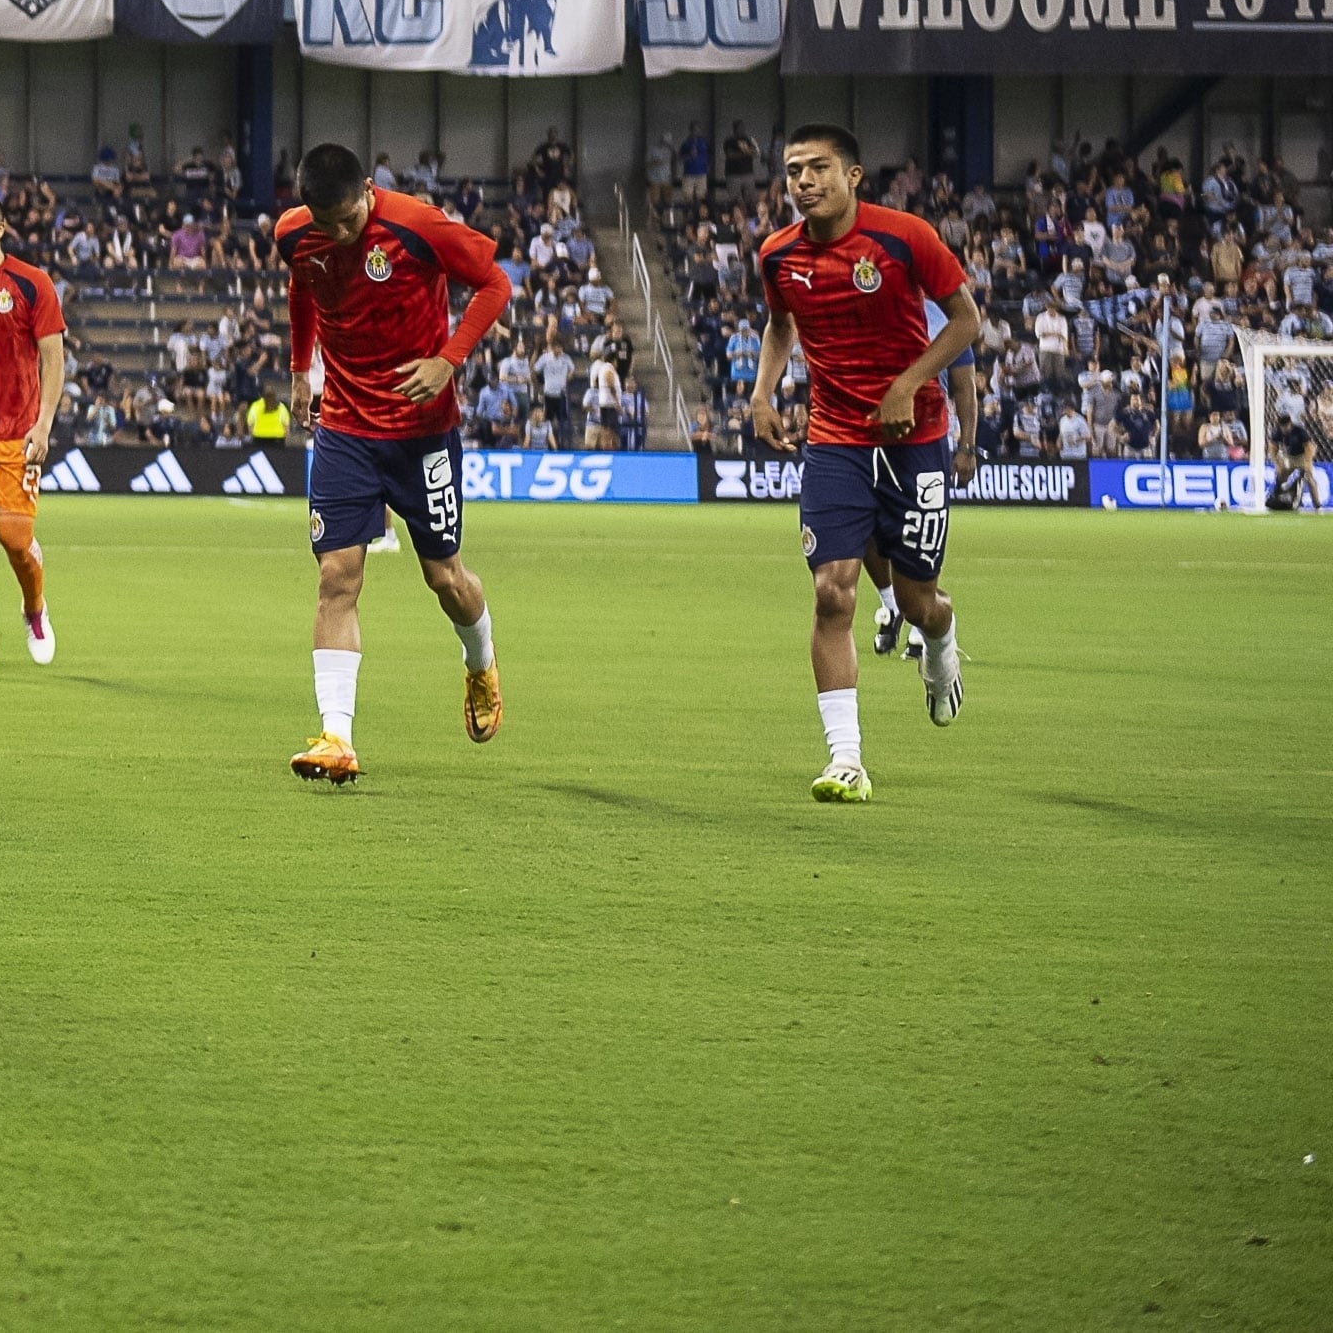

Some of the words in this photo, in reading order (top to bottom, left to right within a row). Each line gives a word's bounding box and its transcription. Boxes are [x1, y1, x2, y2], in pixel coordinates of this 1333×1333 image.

[462, 453, 523, 499] &T
[529, 454, 614, 500] 5G
[427, 485, 458, 532] 59
[902, 509, 948, 552] 207
